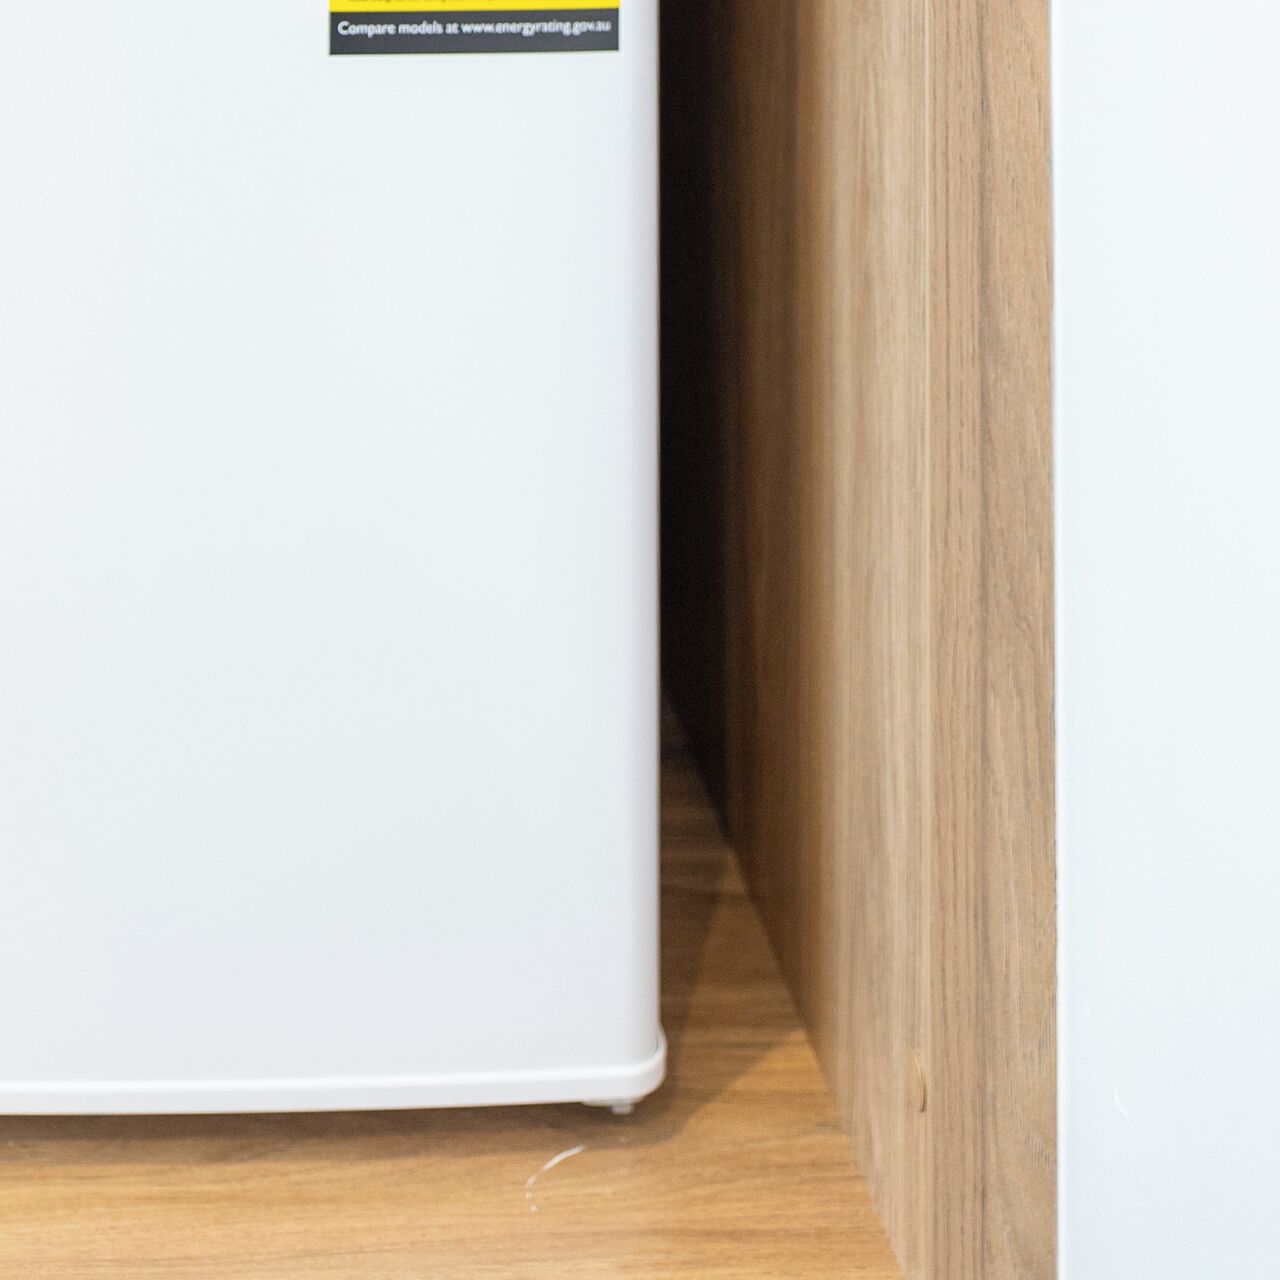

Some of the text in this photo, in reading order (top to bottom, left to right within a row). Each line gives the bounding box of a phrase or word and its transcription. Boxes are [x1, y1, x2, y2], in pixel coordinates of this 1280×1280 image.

[337, 19, 613, 38] Compare models at www.energyrating.gov.au
